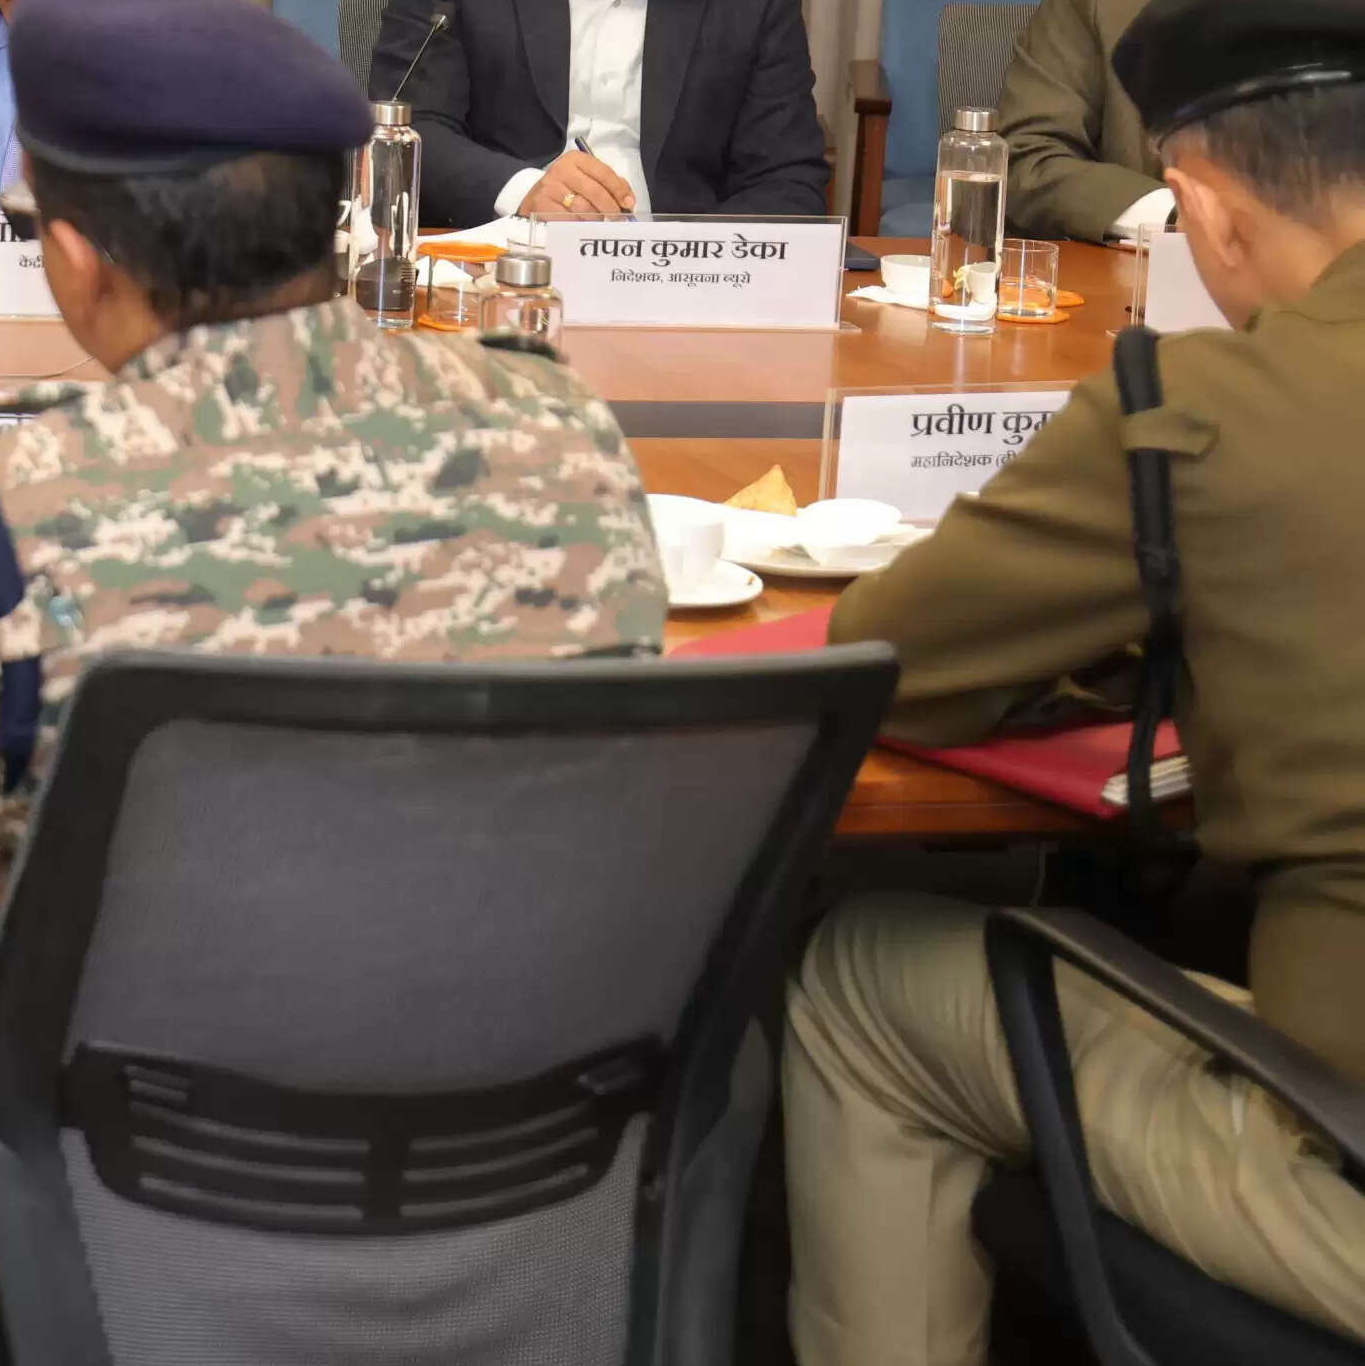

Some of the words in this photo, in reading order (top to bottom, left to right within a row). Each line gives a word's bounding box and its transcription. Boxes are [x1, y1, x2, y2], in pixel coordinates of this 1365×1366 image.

[579, 238, 646, 258] तपन
[650, 239, 726, 267] कुमार
[731, 233, 789, 260] डेका
[667, 271, 720, 288] आसूचना
[910, 403, 997, 437] प्रवीण
[910, 450, 993, 469] महानिदेशक
